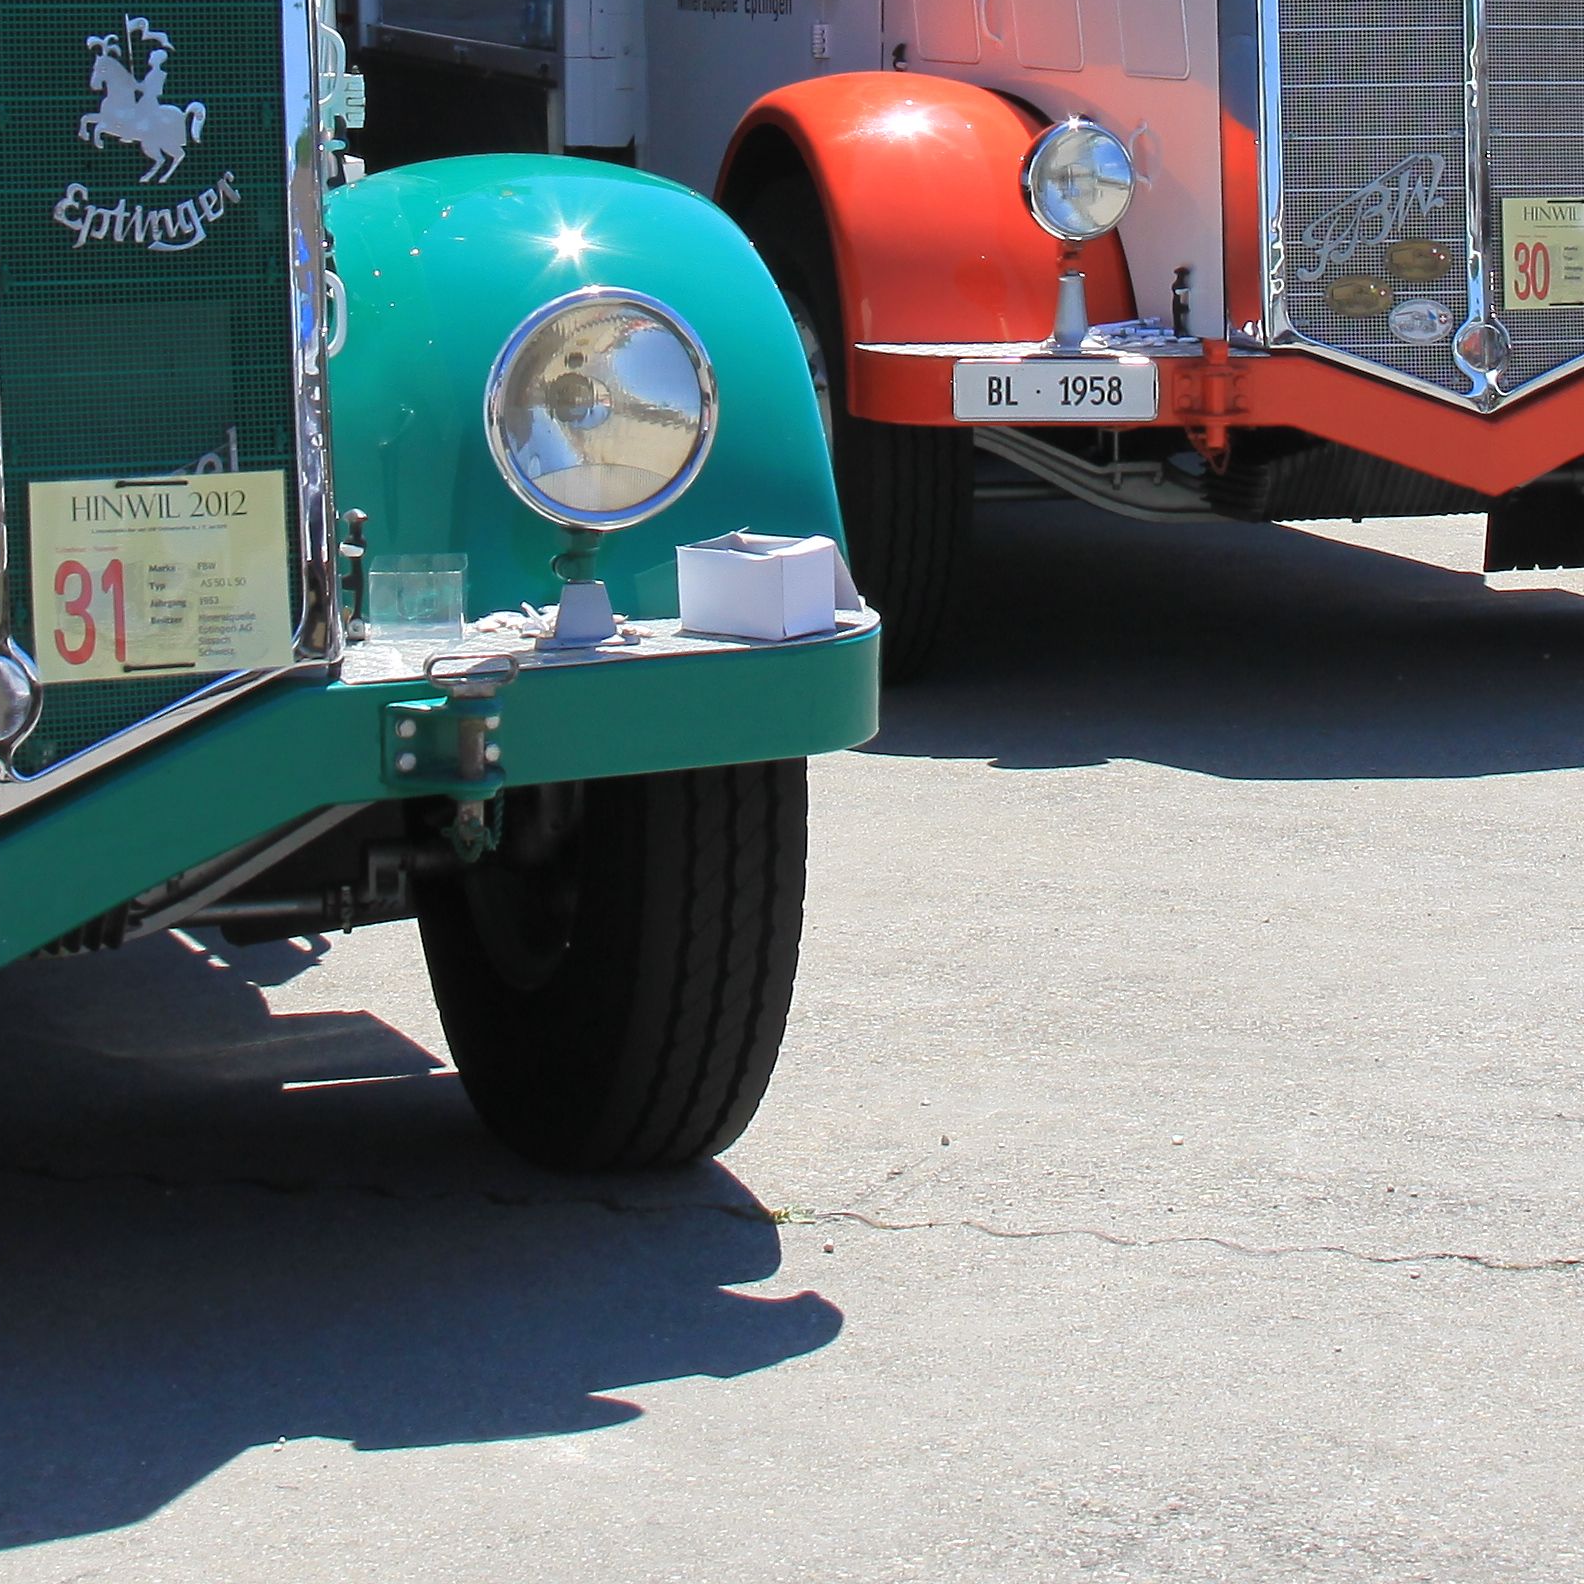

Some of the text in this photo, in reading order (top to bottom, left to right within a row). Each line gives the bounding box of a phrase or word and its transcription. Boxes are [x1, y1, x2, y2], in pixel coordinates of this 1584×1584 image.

[53, 169, 242, 252] Eptinger
[1296, 152, 1446, 282] FBW
[1523, 205, 1582, 222] HINWIL
[1514, 241, 1551, 301] 30
[987, 375, 1124, 406] BL 1958
[72, 489, 249, 522] HINWIL 2012
[53, 558, 126, 665] 31
